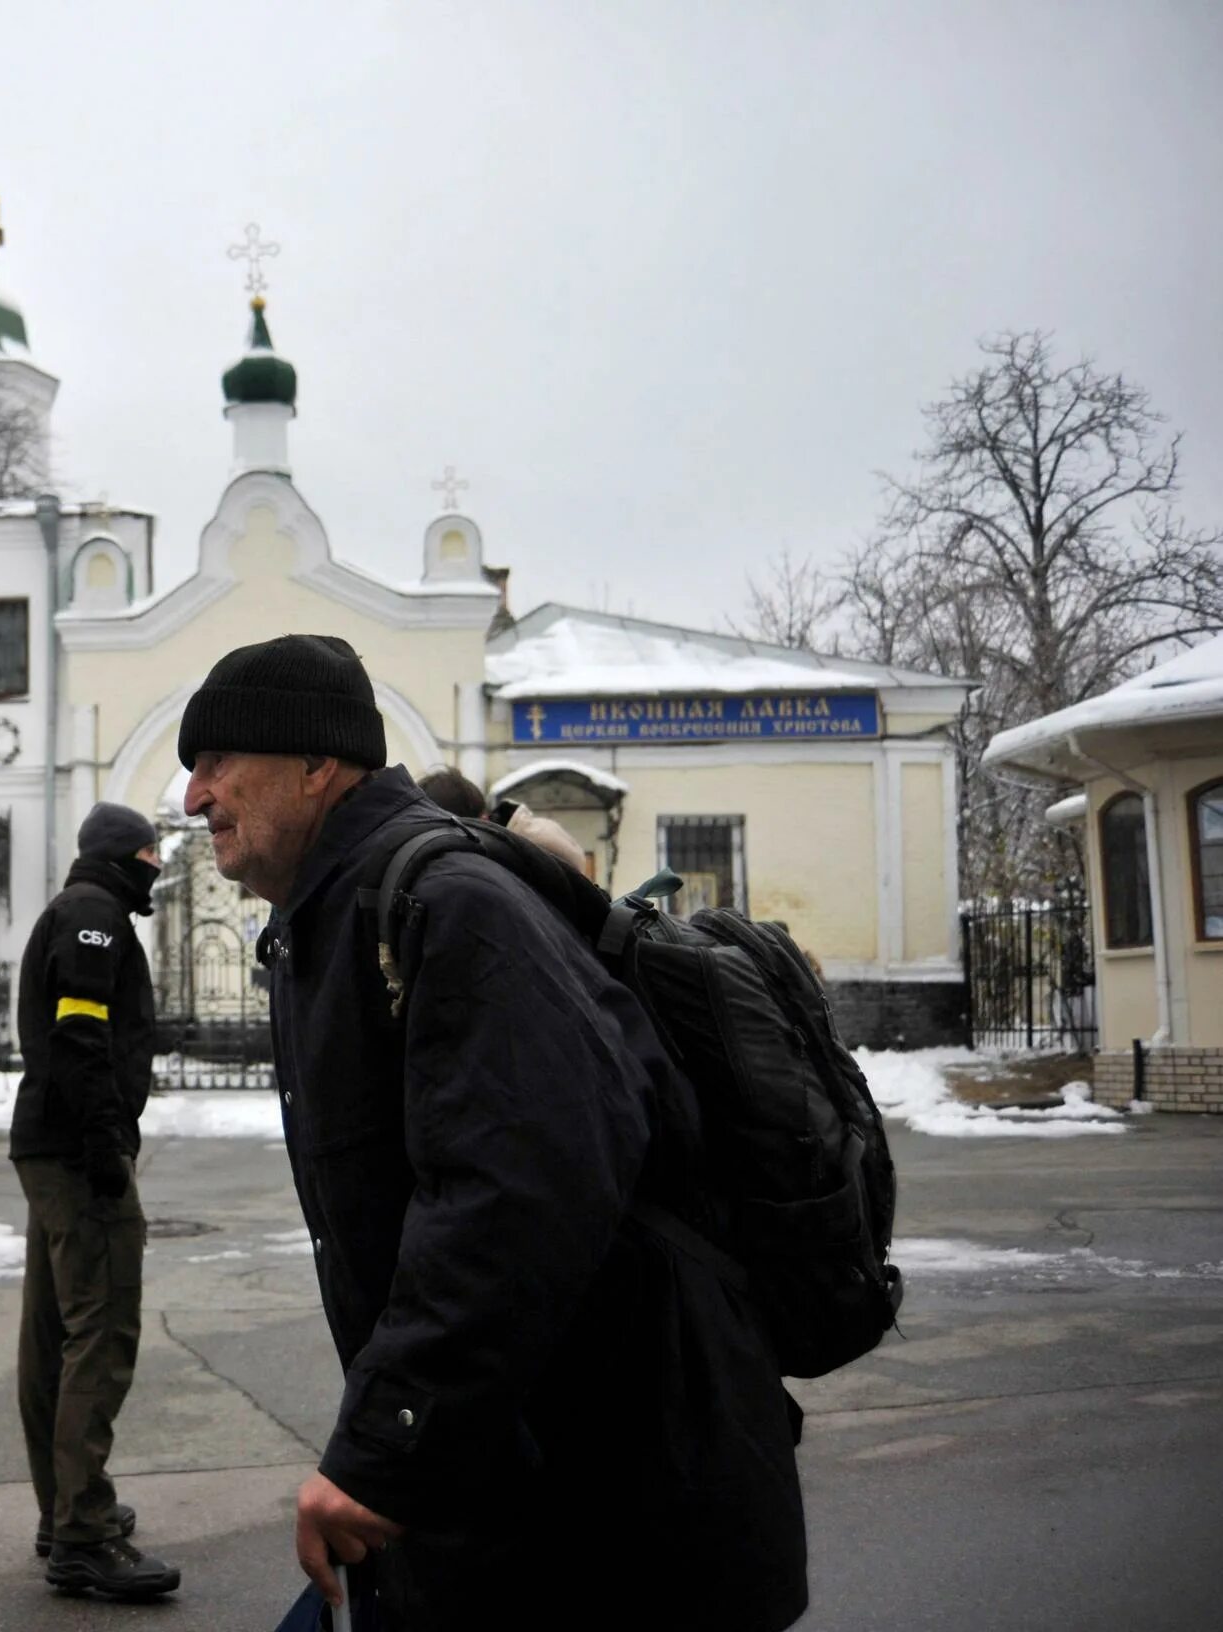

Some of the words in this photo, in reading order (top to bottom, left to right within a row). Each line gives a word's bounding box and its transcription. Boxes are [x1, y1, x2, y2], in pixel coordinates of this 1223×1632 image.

[590, 702, 723, 721] ИКОННАЯ
[740, 697, 831, 718] ЛАВКА
[772, 718, 862, 734] ХРИСТОВА
[78, 929, 113, 947] СБУ
